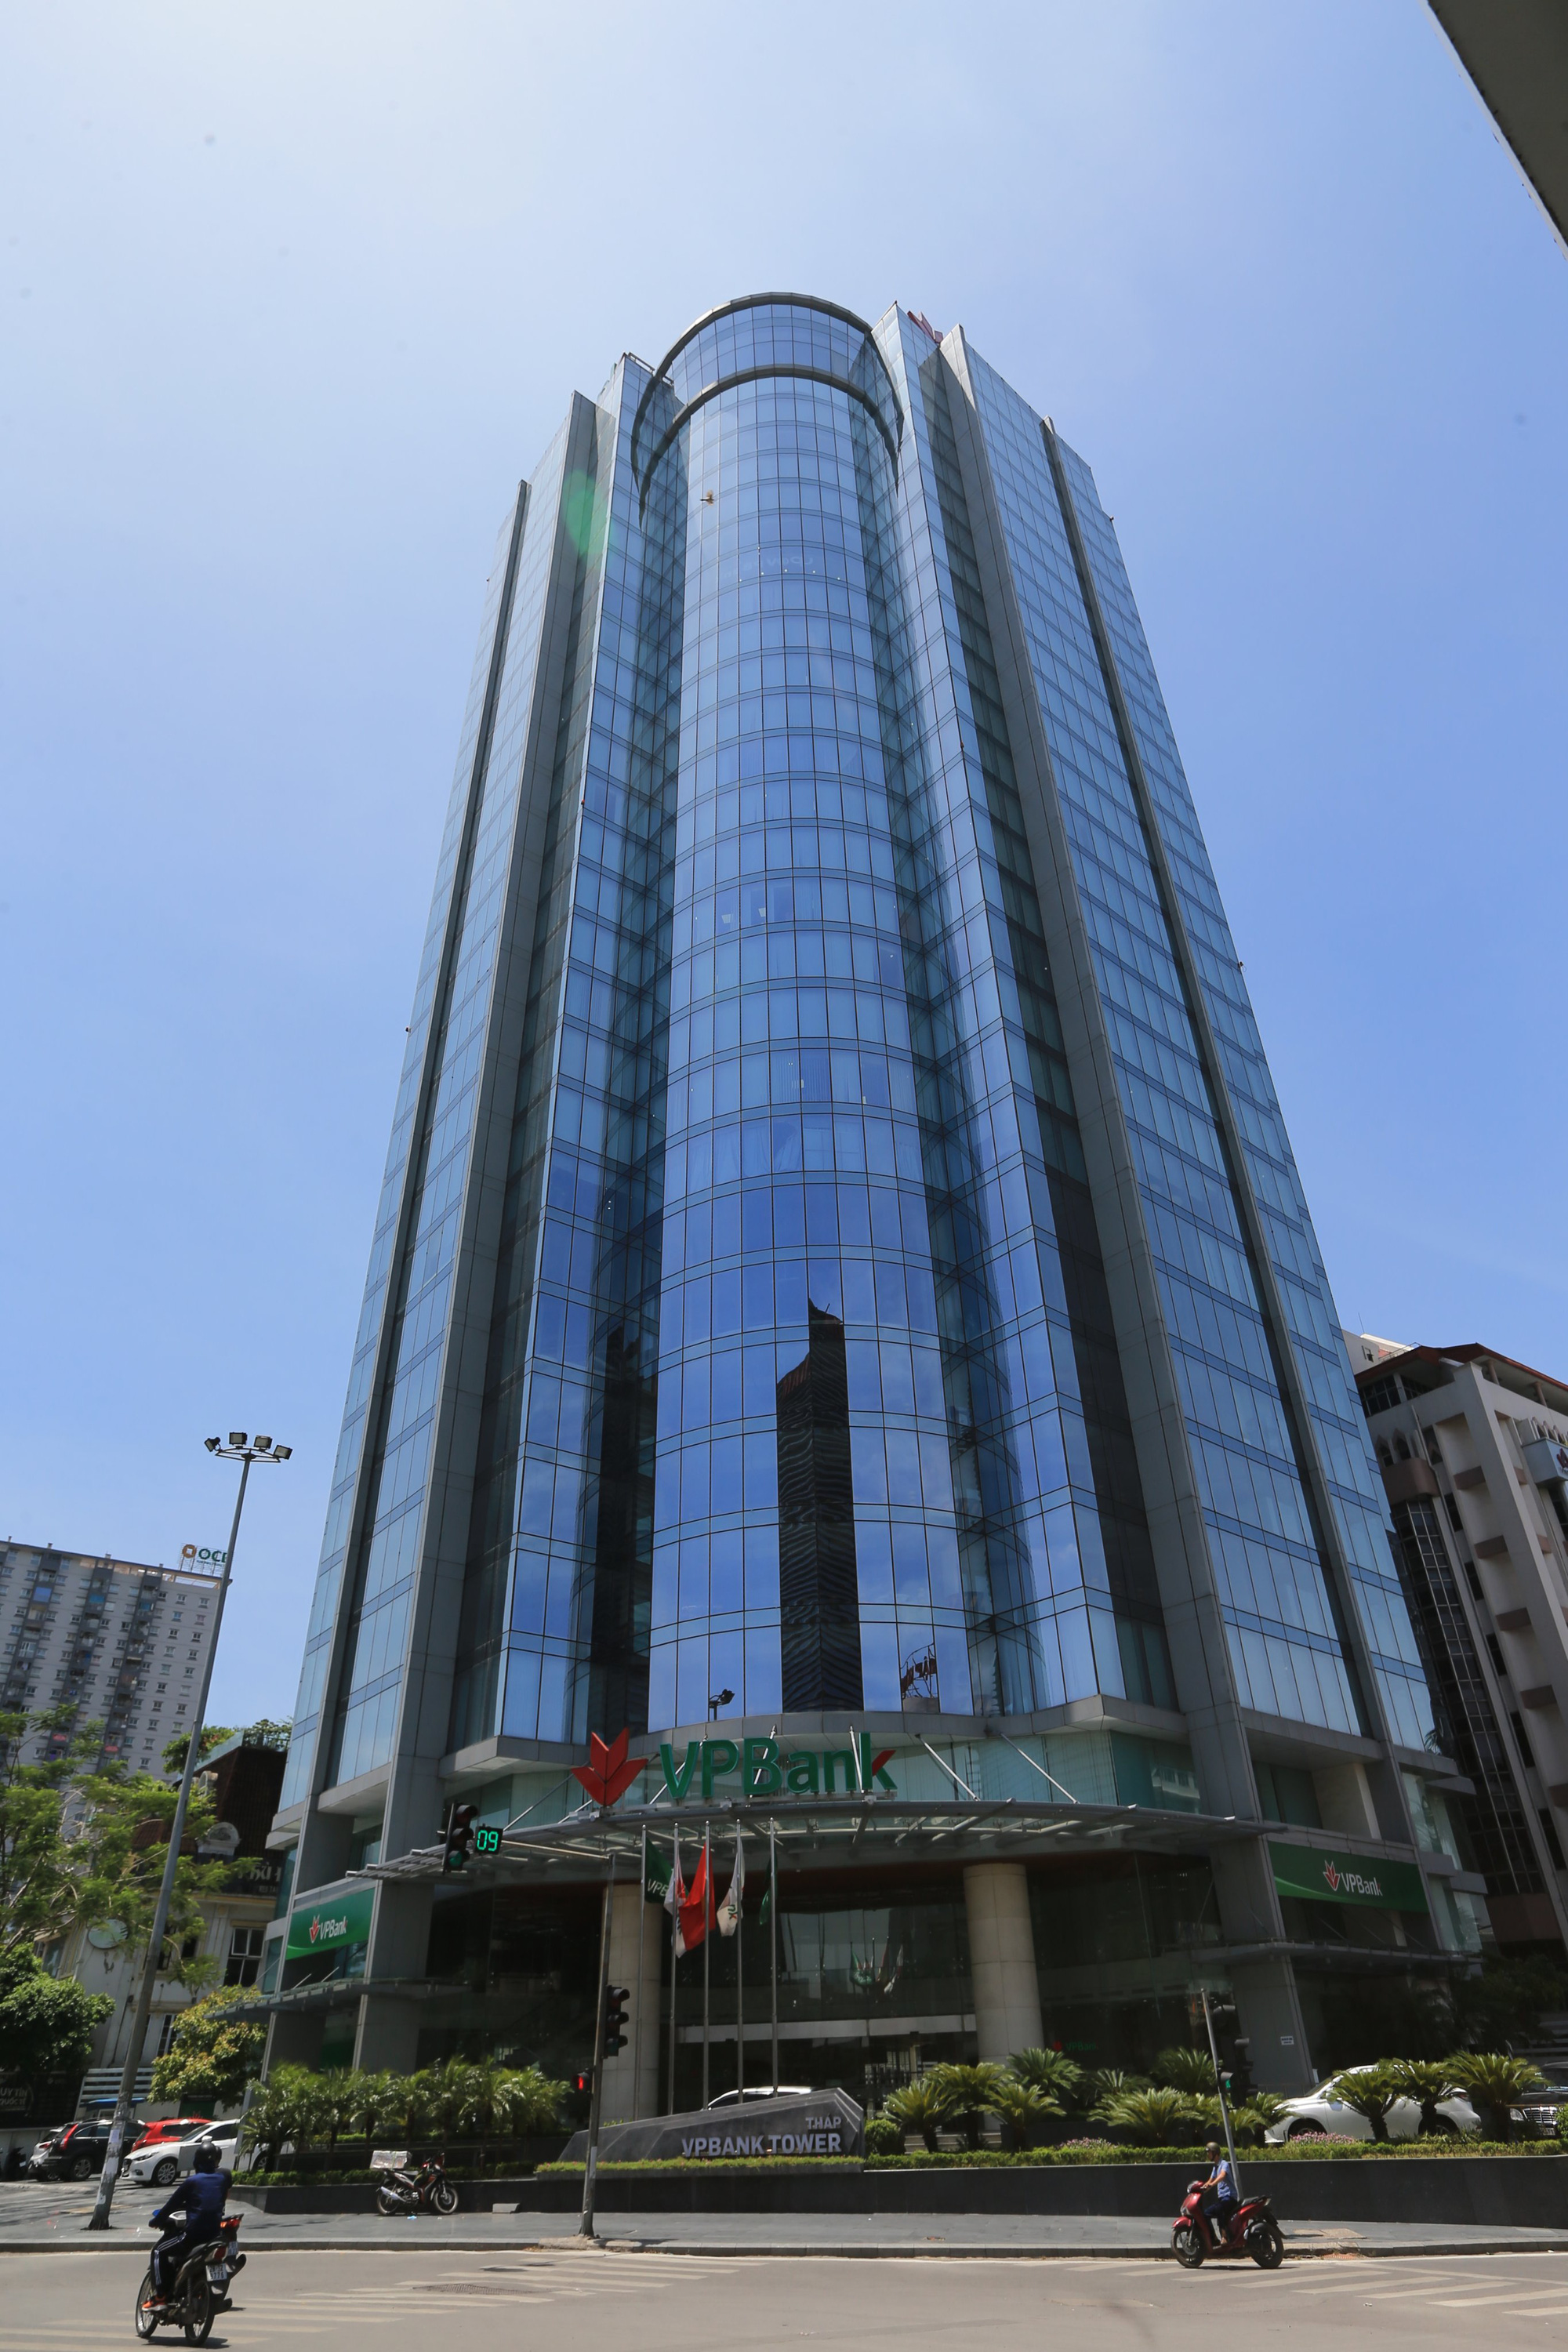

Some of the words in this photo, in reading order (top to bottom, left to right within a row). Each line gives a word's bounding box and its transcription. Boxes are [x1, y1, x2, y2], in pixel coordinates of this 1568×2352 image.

[659, 1732, 898, 1799] VPBank
[477, 1830, 499, 1851] 09
[1340, 1872, 1383, 1896] VPBank
[320, 1915, 348, 1940] VPBank
[805, 2113, 841, 2130] THÁP
[681, 2135, 764, 2157] VPBANK
[768, 2132, 842, 2154] TOWER
